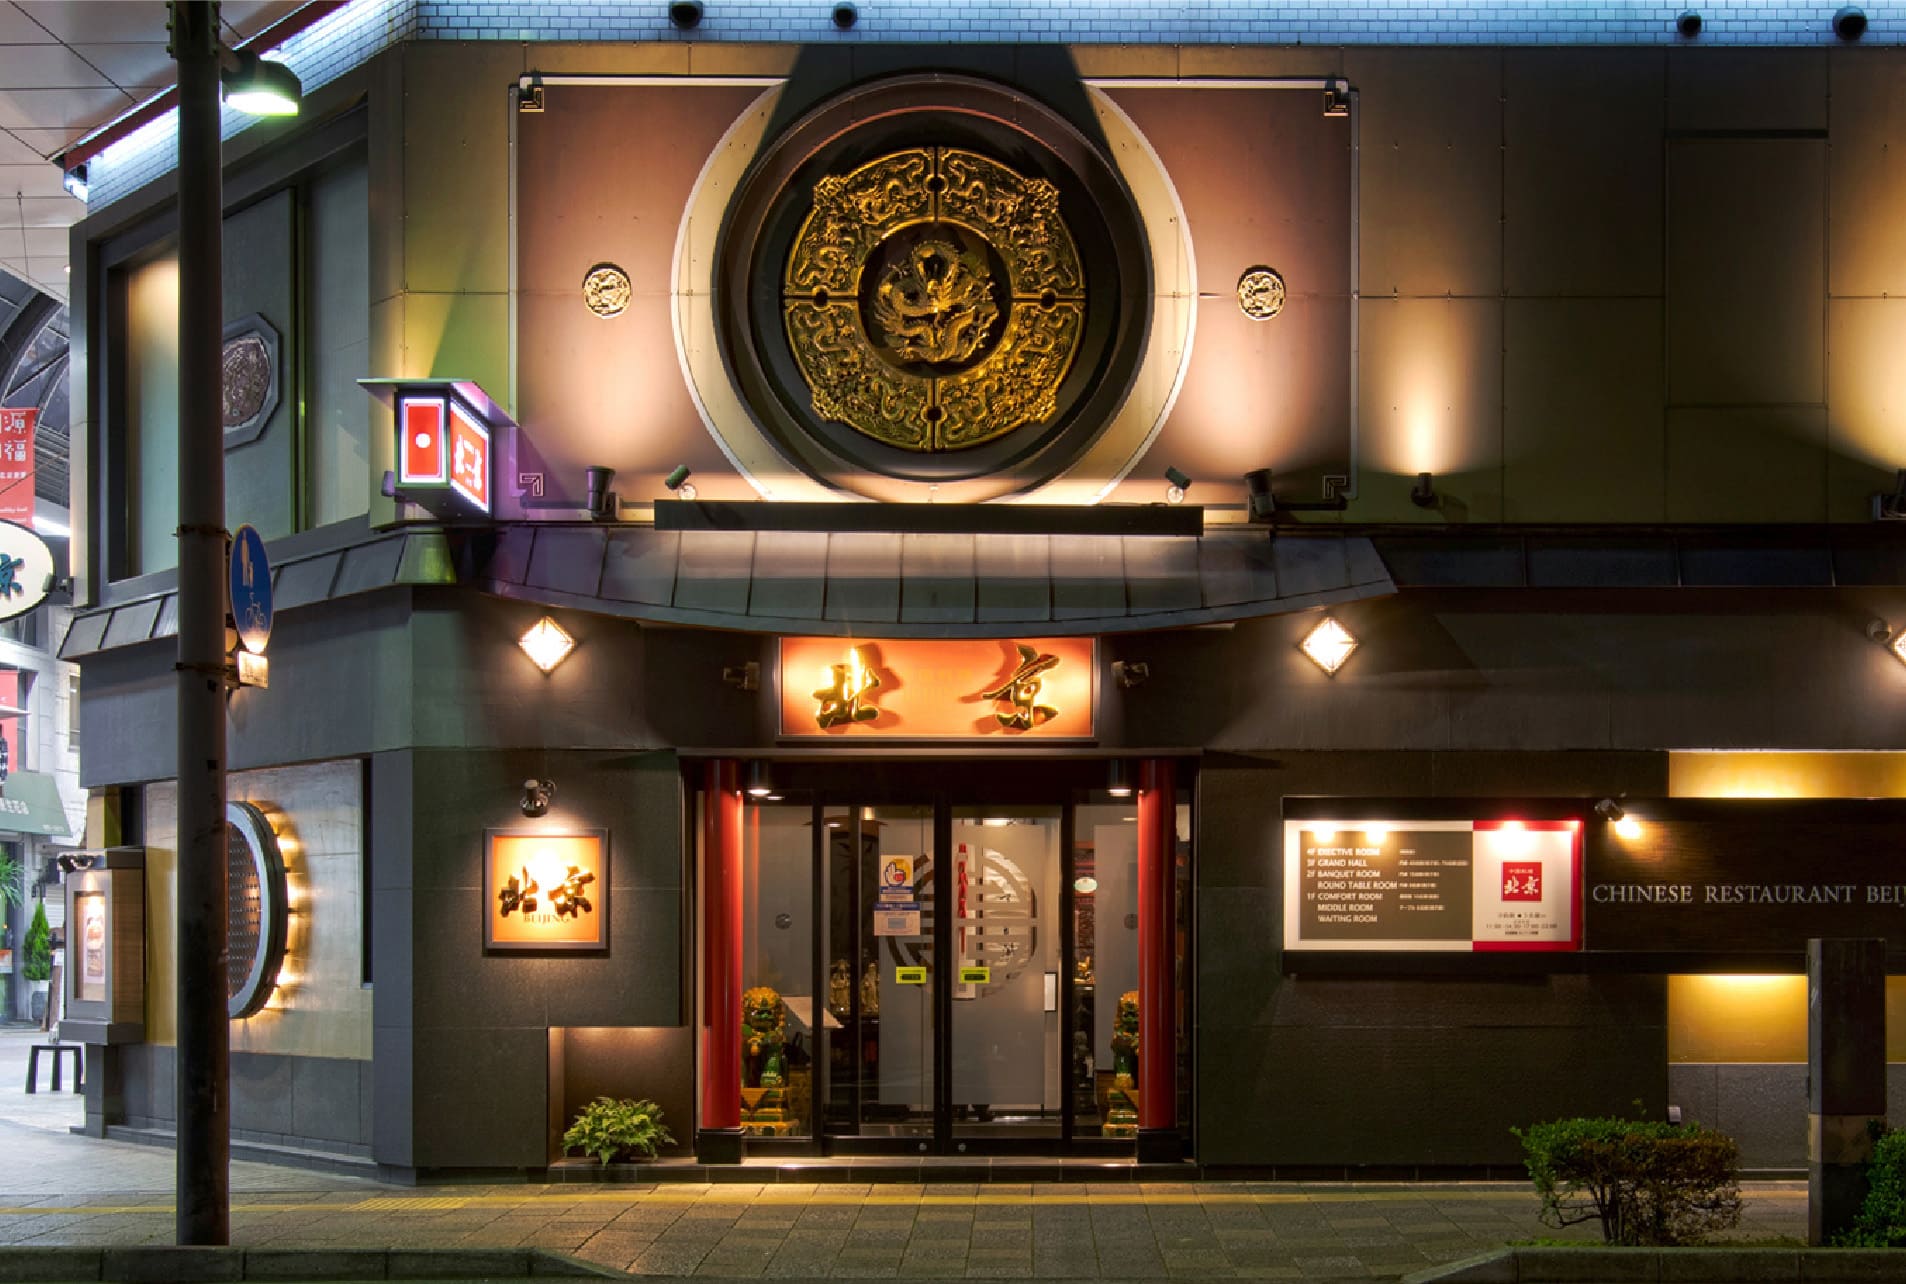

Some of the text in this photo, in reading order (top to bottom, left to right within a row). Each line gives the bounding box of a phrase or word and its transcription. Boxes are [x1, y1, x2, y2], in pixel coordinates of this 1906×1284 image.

[0, 411, 26, 434] 源
[0, 440, 27, 461] 福
[1317, 859, 1347, 867] GRAND
[1348, 859, 1368, 867] HALL
[1317, 870, 1355, 878] BANQUET
[1355, 870, 1381, 878] ROOM
[1317, 881, 1347, 890] ROUND
[1347, 881, 1372, 890] TABLE
[1373, 881, 1398, 890] ROOM
[1317, 893, 1356, 901] COMFORT
[1358, 893, 1384, 901] ROOM
[1592, 884, 1693, 903] CHINESE
[1704, 884, 1857, 904] RESTAURANT
[1317, 903, 1374, 912] MIDDLE ROOM
[1317, 914, 1378, 923] WAITING ROOM
